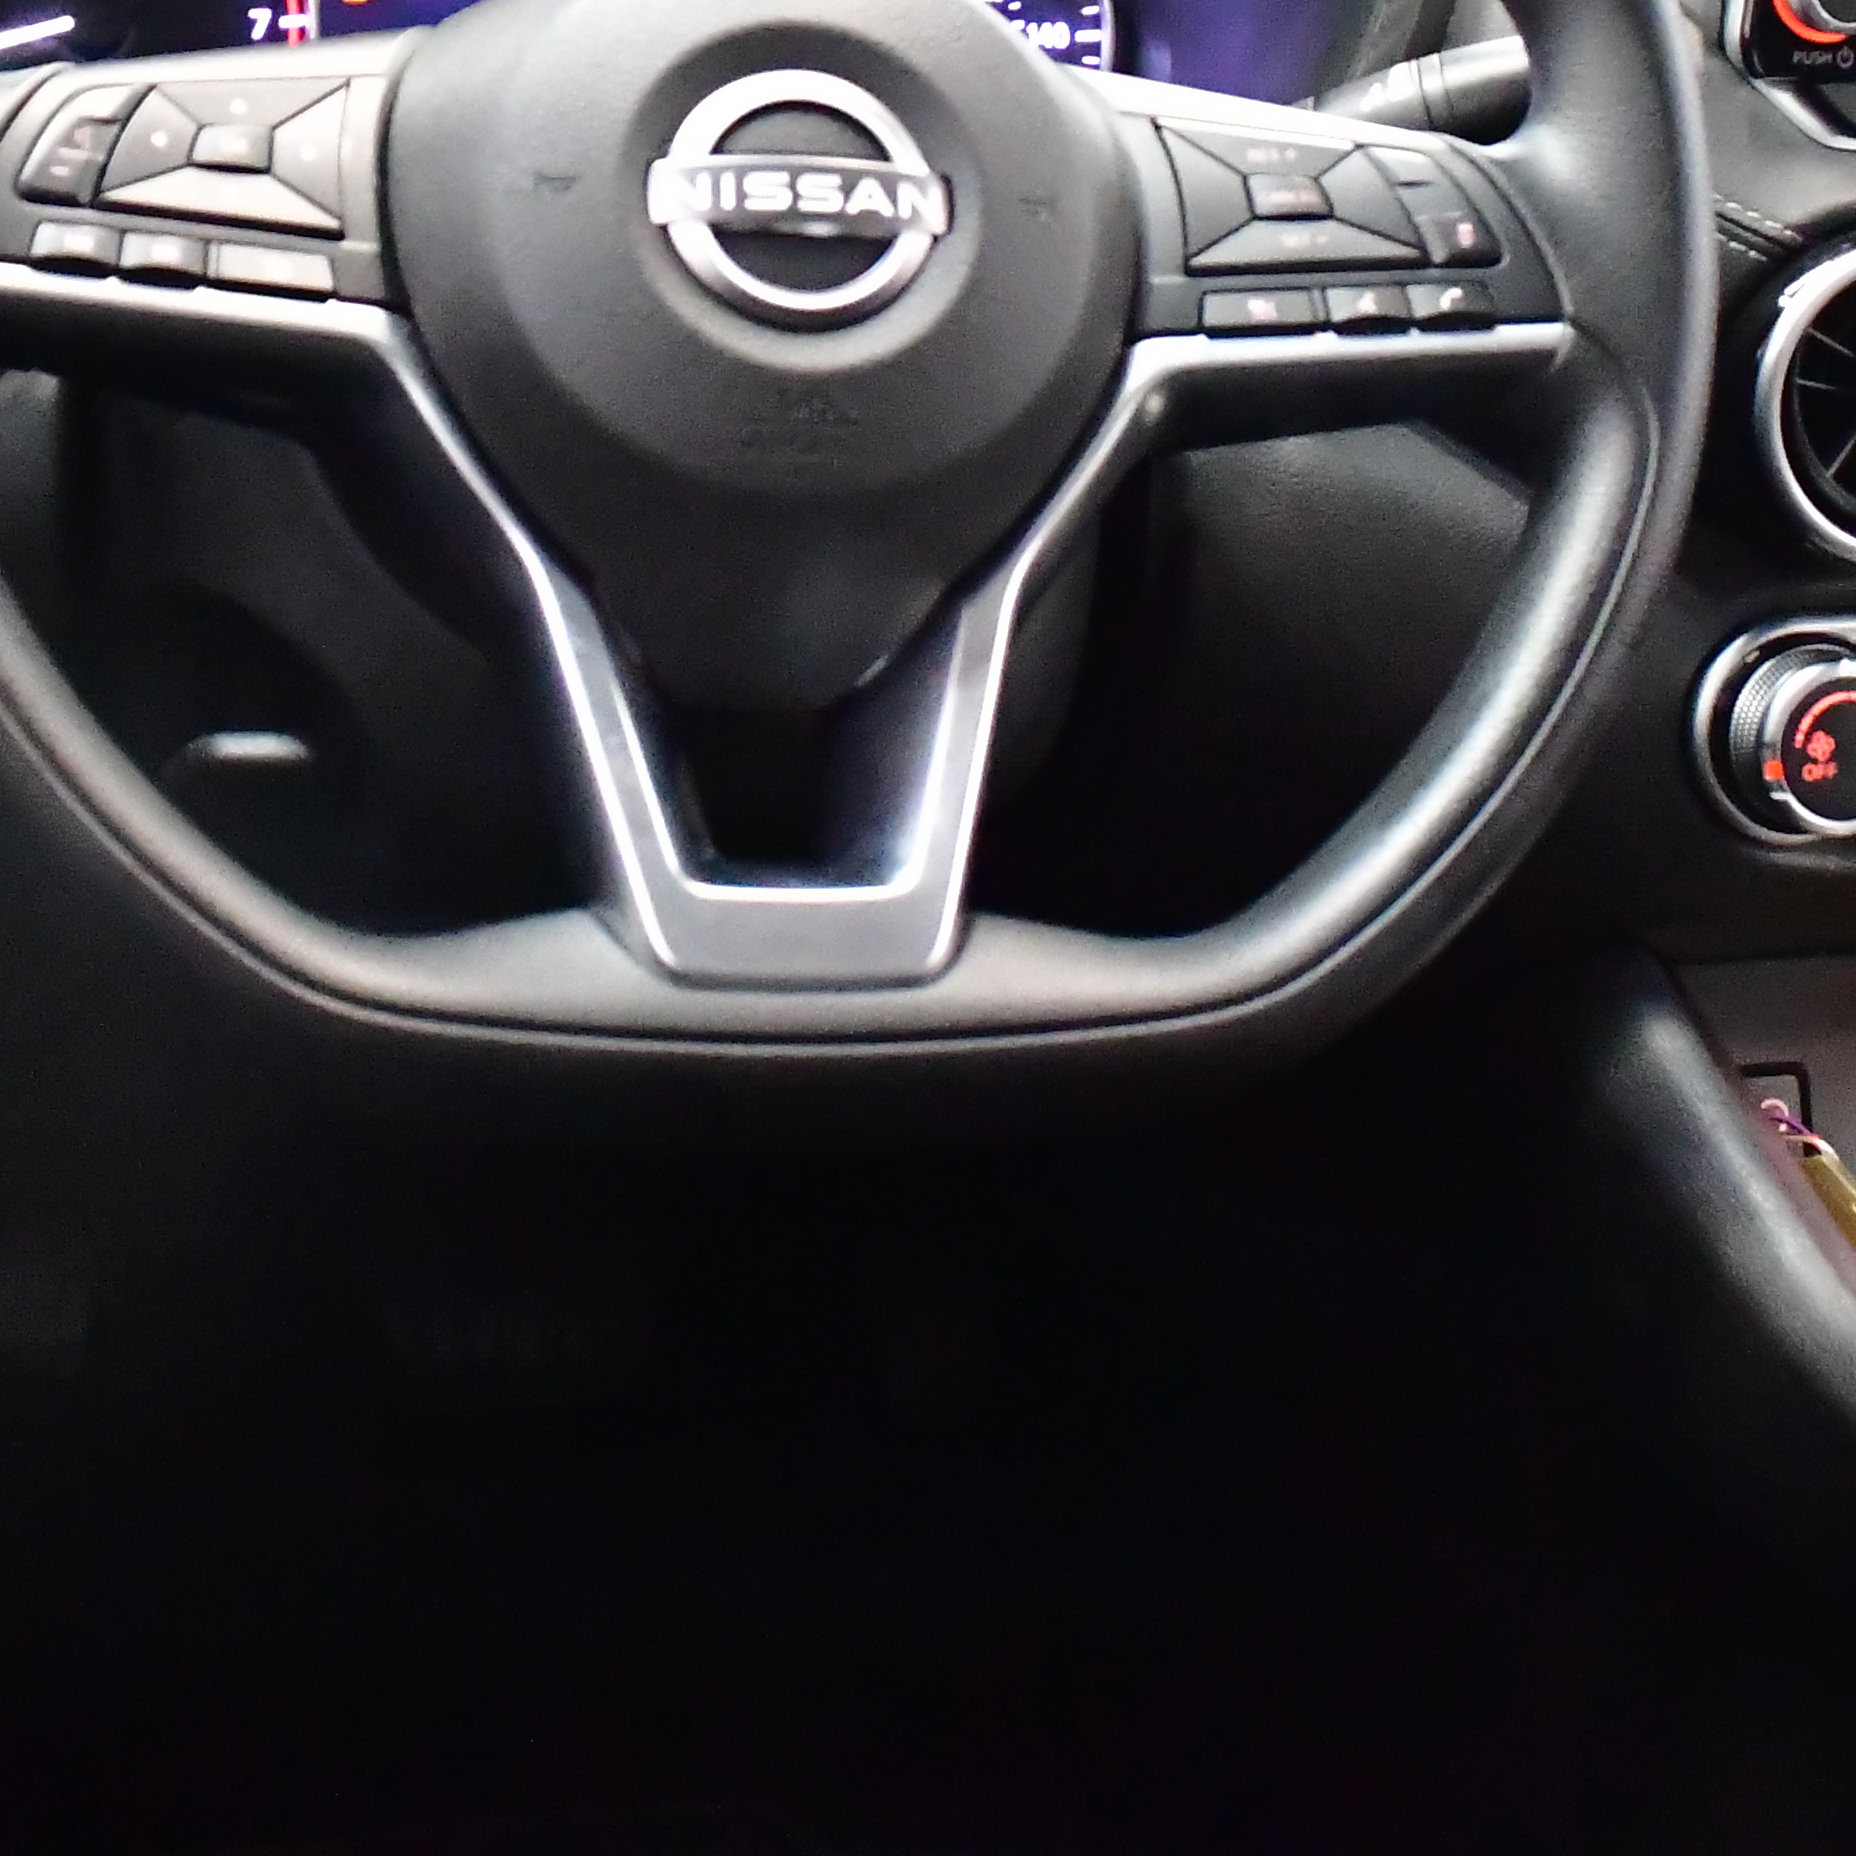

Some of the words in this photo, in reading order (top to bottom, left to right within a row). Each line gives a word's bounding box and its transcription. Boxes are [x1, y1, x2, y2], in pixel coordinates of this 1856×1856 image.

[247, 7, 273, 40] 7
[664, 170, 943, 228] NISSAN
[1801, 761, 1838, 782] OFF
